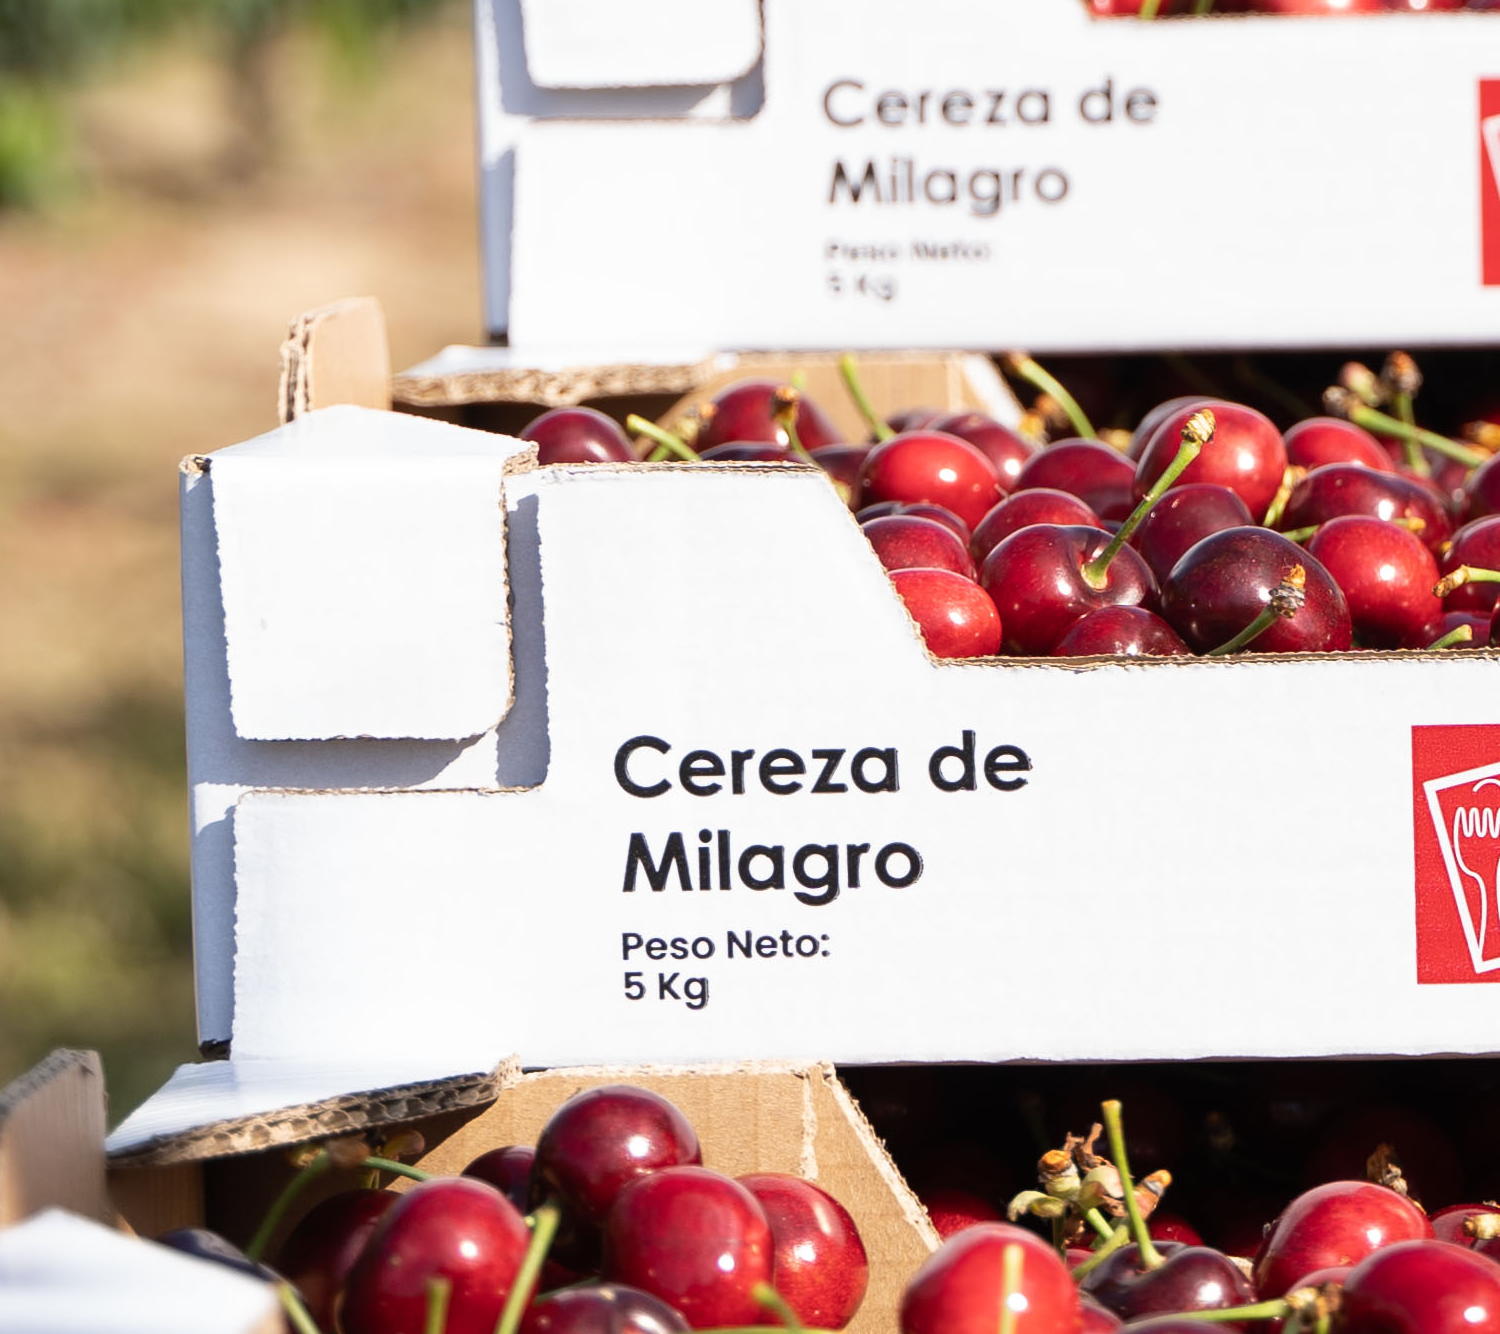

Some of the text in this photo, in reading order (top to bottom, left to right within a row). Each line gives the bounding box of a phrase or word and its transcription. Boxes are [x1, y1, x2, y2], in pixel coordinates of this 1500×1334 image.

[821, 75, 1159, 129] Cereza de
[826, 156, 1070, 219] Milagro
[614, 729, 1033, 799] Cereza de
[622, 828, 924, 906] Milagro
[621, 929, 830, 961] Peso Neto:
[623, 971, 710, 1011] 5 Kg
